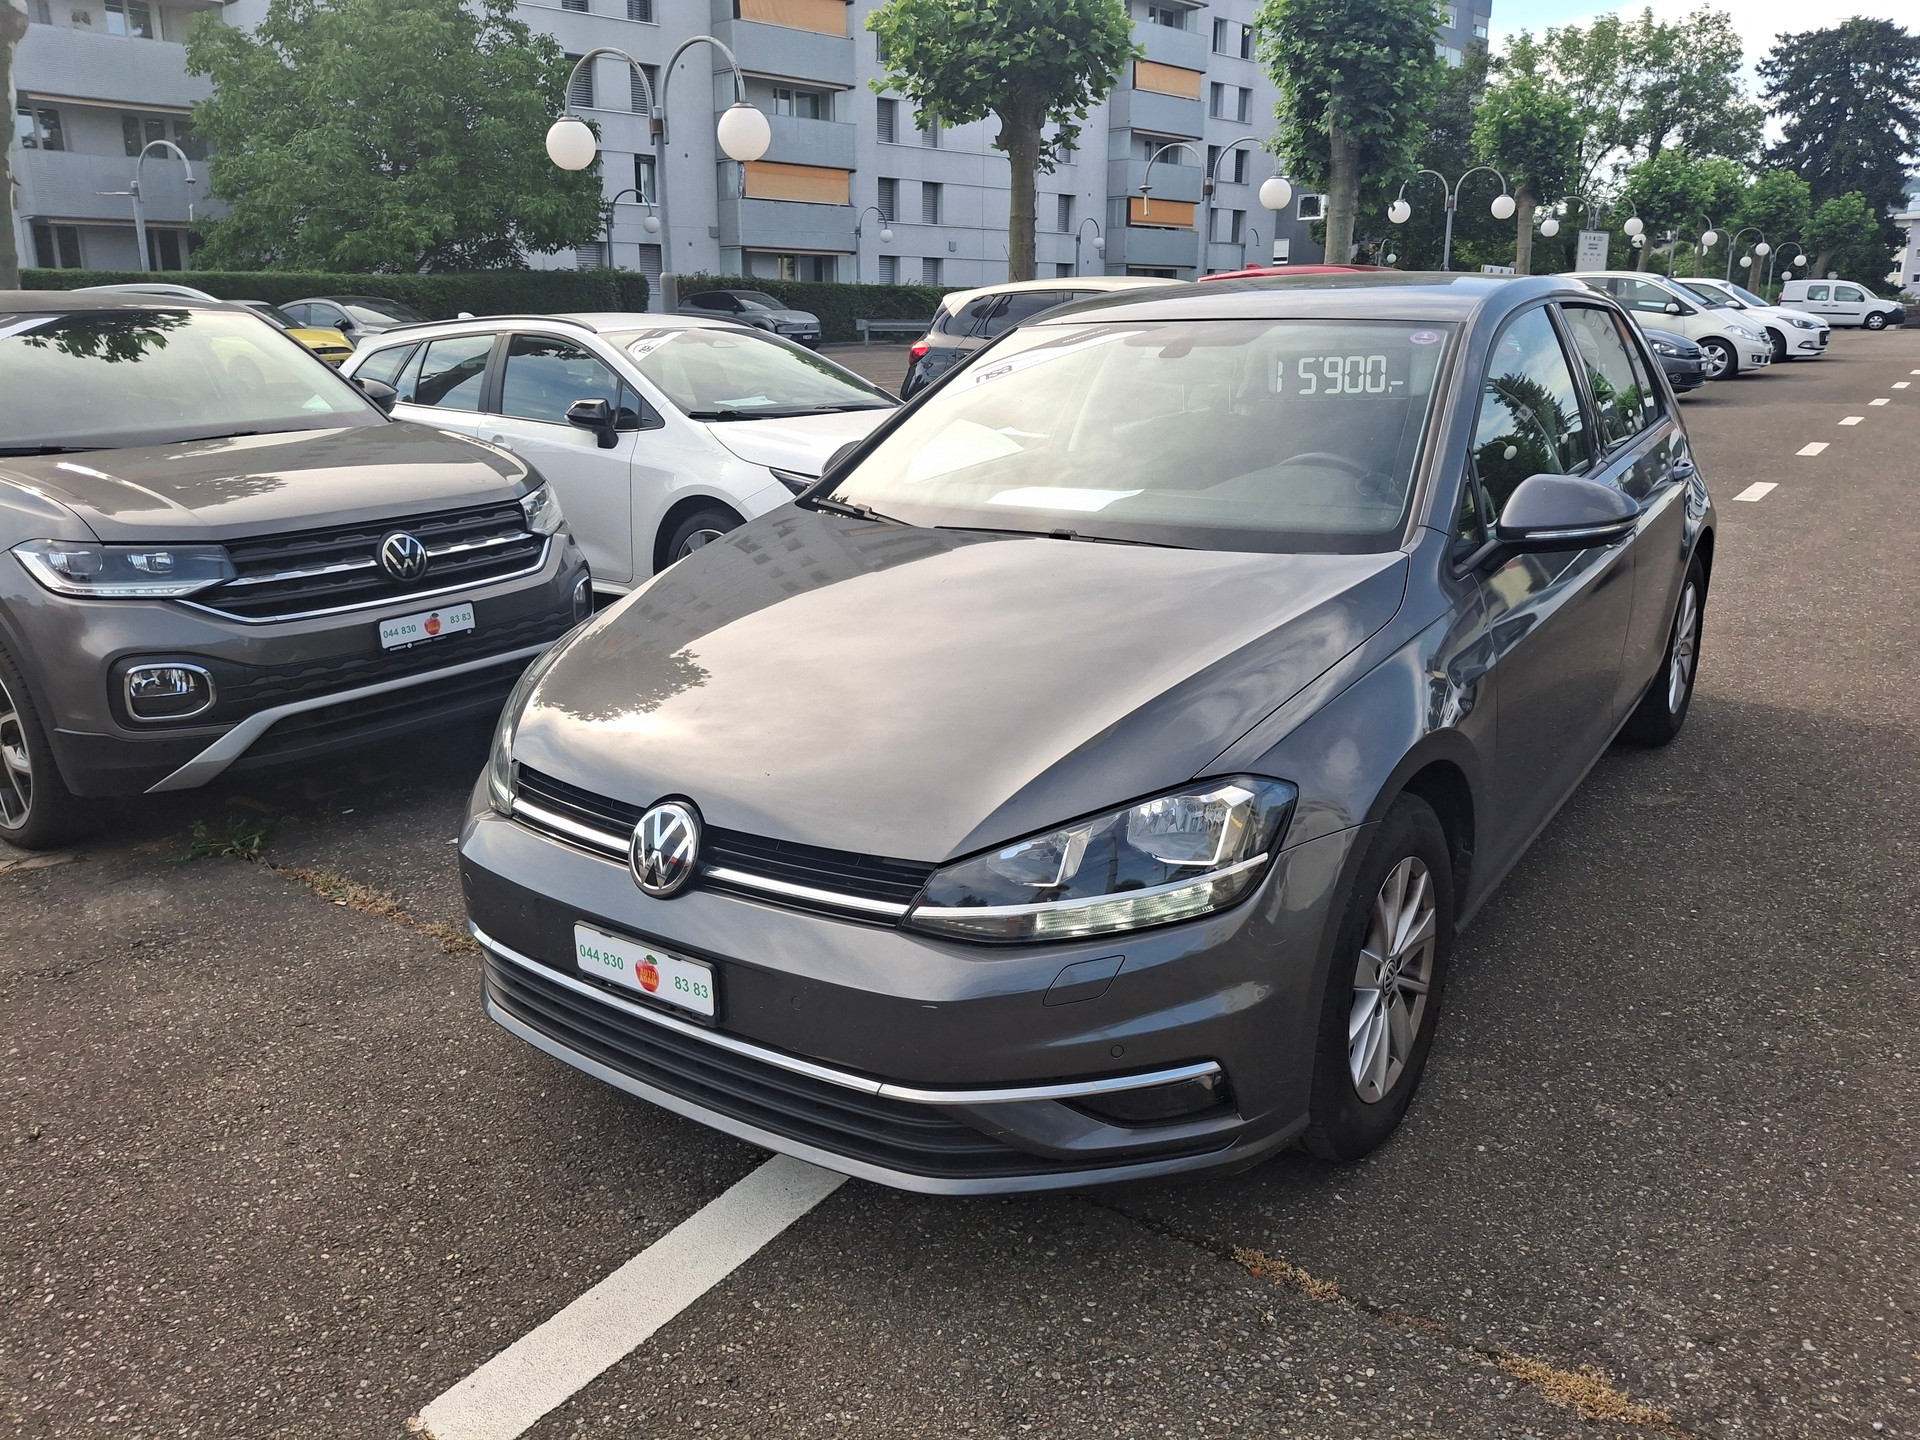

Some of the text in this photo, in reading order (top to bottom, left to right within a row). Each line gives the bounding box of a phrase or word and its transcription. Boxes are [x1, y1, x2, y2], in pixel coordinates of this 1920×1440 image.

[976, 365, 1013, 384] nsa
[383, 628, 399, 639] 044
[401, 624, 417, 635] 830
[450, 616, 460, 624] 83
[461, 612, 472, 621] 83
[579, 944, 709, 999] 044 830 83 83
[640, 968, 656, 979] AUTO
